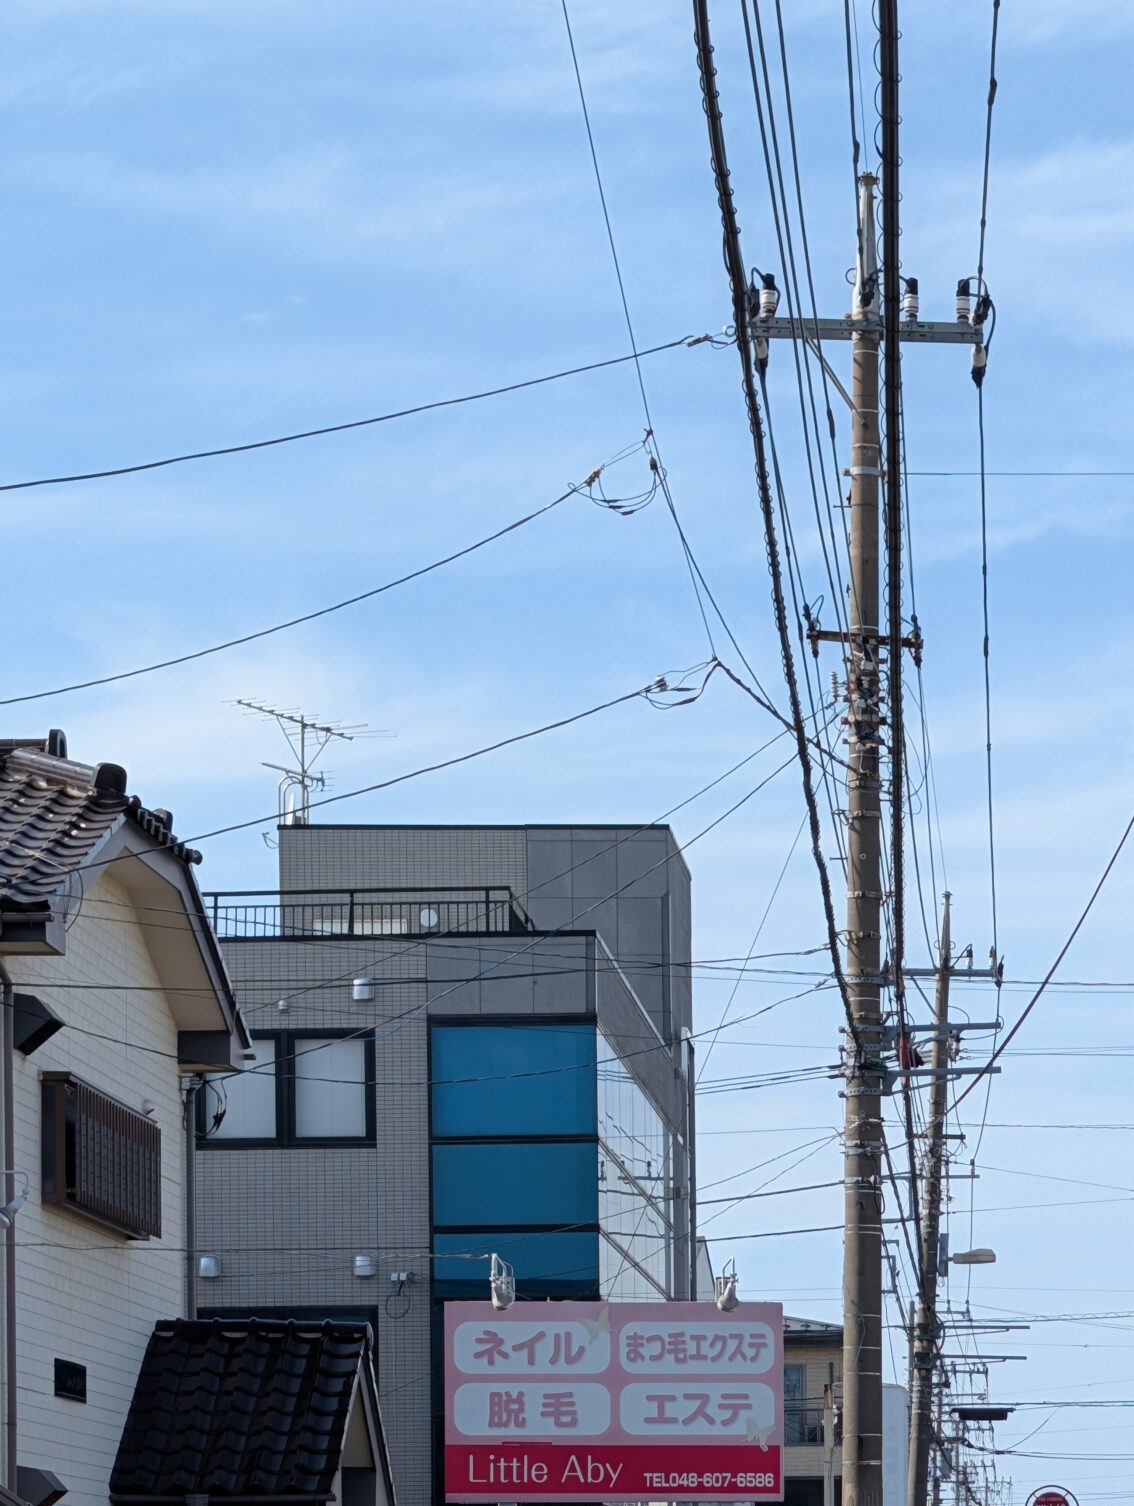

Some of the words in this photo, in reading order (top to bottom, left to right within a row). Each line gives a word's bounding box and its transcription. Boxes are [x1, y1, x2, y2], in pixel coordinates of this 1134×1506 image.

[473, 1329, 586, 1366] ネイル
[625, 1331, 768, 1364] まつ毛エクステ
[487, 1390, 578, 1428] 脱毛
[643, 1392, 753, 1427] エステ
[469, 1454, 549, 1483] Little
[561, 1454, 623, 1488] Aby
[643, 1472, 774, 1488] TEL048-607-6586
